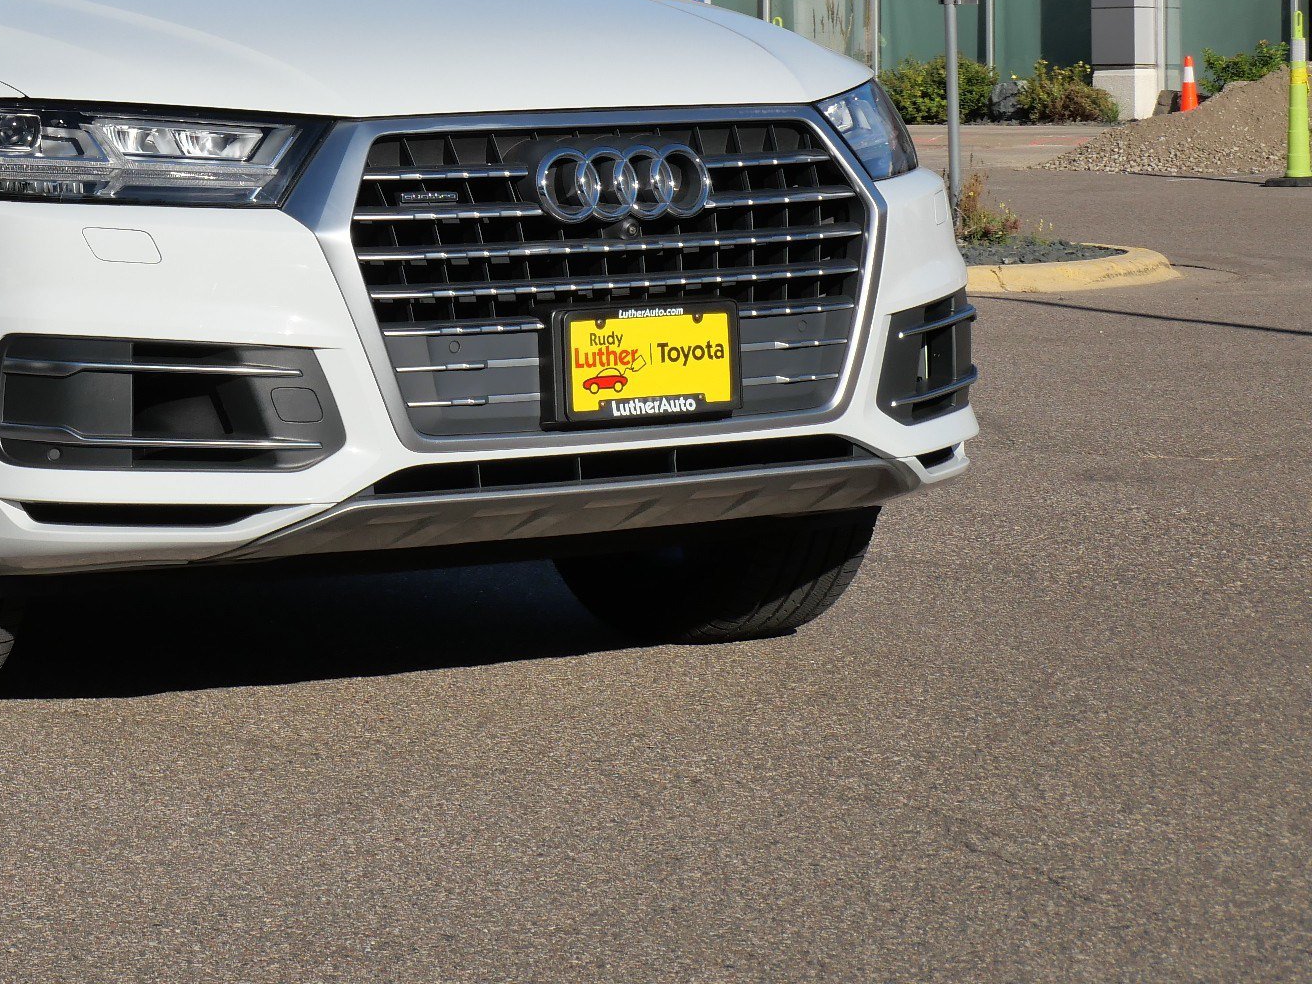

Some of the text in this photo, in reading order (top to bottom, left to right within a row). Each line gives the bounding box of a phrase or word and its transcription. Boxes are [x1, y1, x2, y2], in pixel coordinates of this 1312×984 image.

[618, 308, 684, 318] LutherAuto.com
[589, 331, 623, 347] Rudy
[574, 346, 638, 368] Luther
[657, 340, 725, 366] Toyota
[612, 397, 697, 416] LutherAuto
